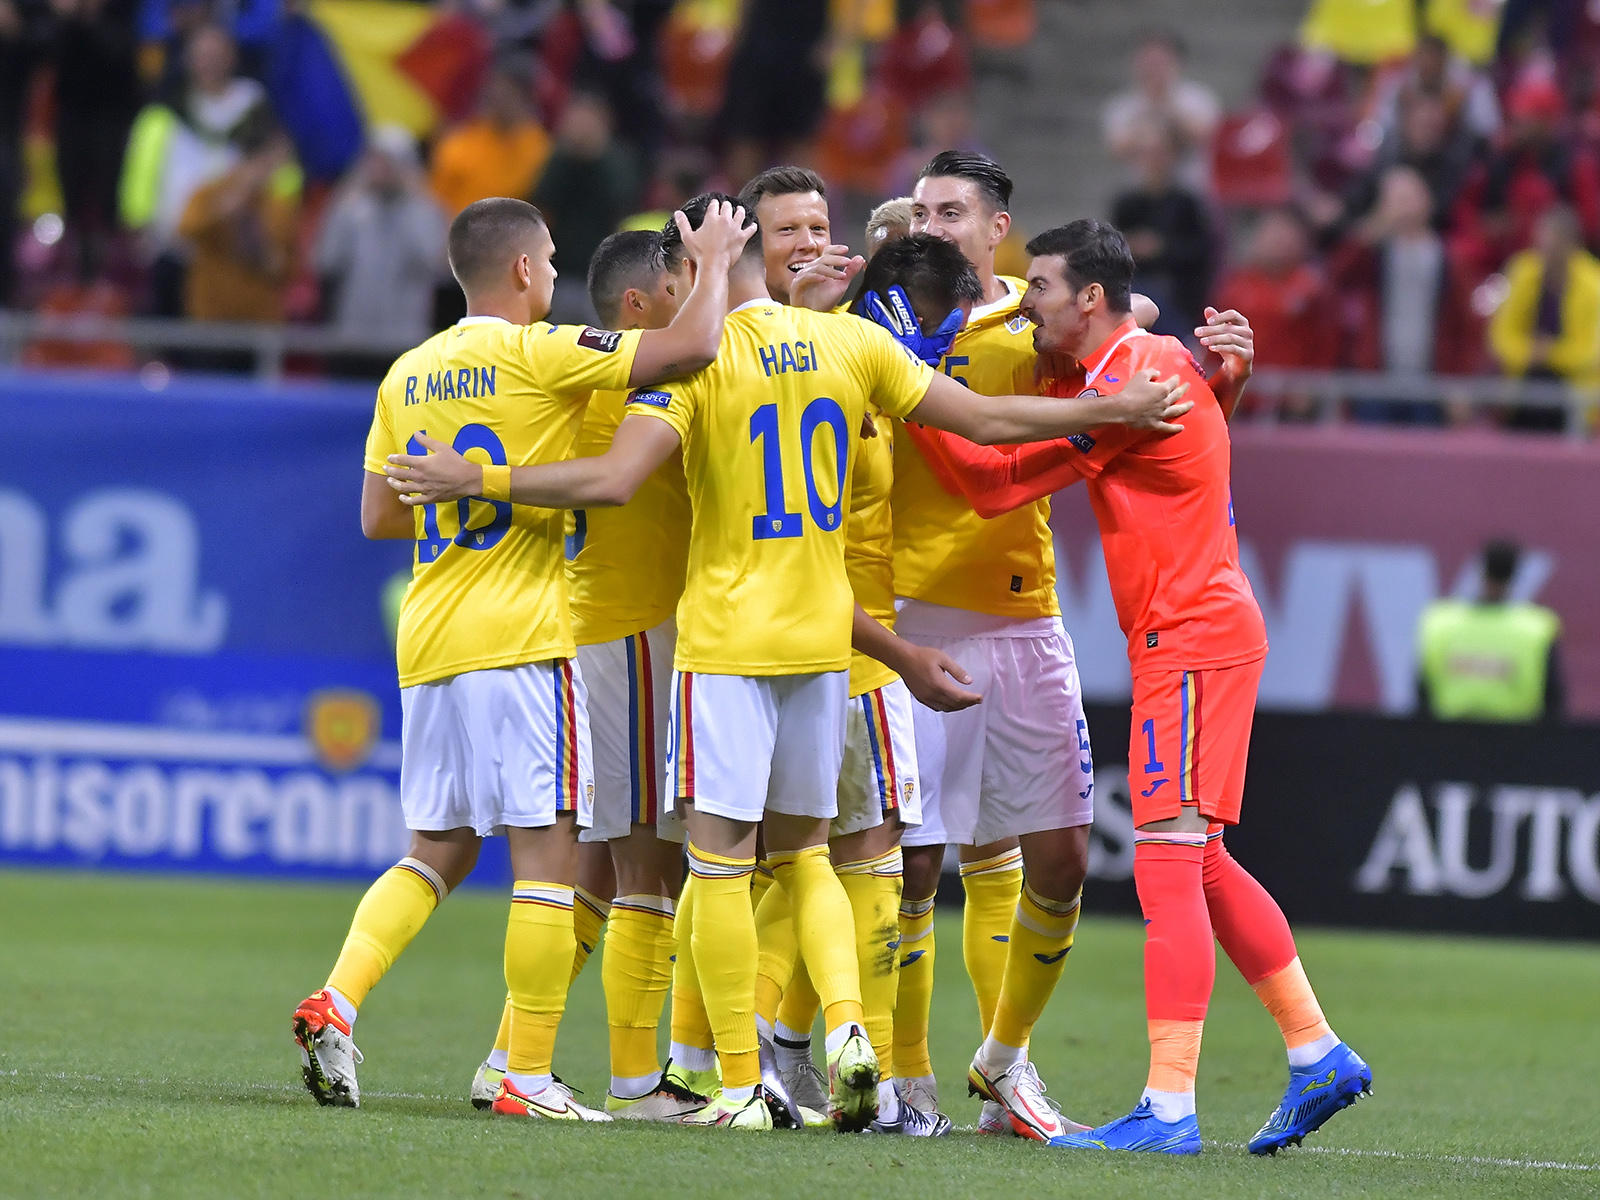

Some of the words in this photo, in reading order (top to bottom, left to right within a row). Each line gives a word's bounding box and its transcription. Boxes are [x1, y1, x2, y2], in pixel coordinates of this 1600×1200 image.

[888, 290, 918, 335] reusch
[758, 340, 818, 378] HAGI
[404, 375, 420, 407] R.
[425, 365, 496, 403] MARIN
[634, 393, 671, 405] RESPECT
[749, 397, 849, 541] 10
[1076, 719, 1093, 774] 5
[1142, 719, 1164, 774] 1
